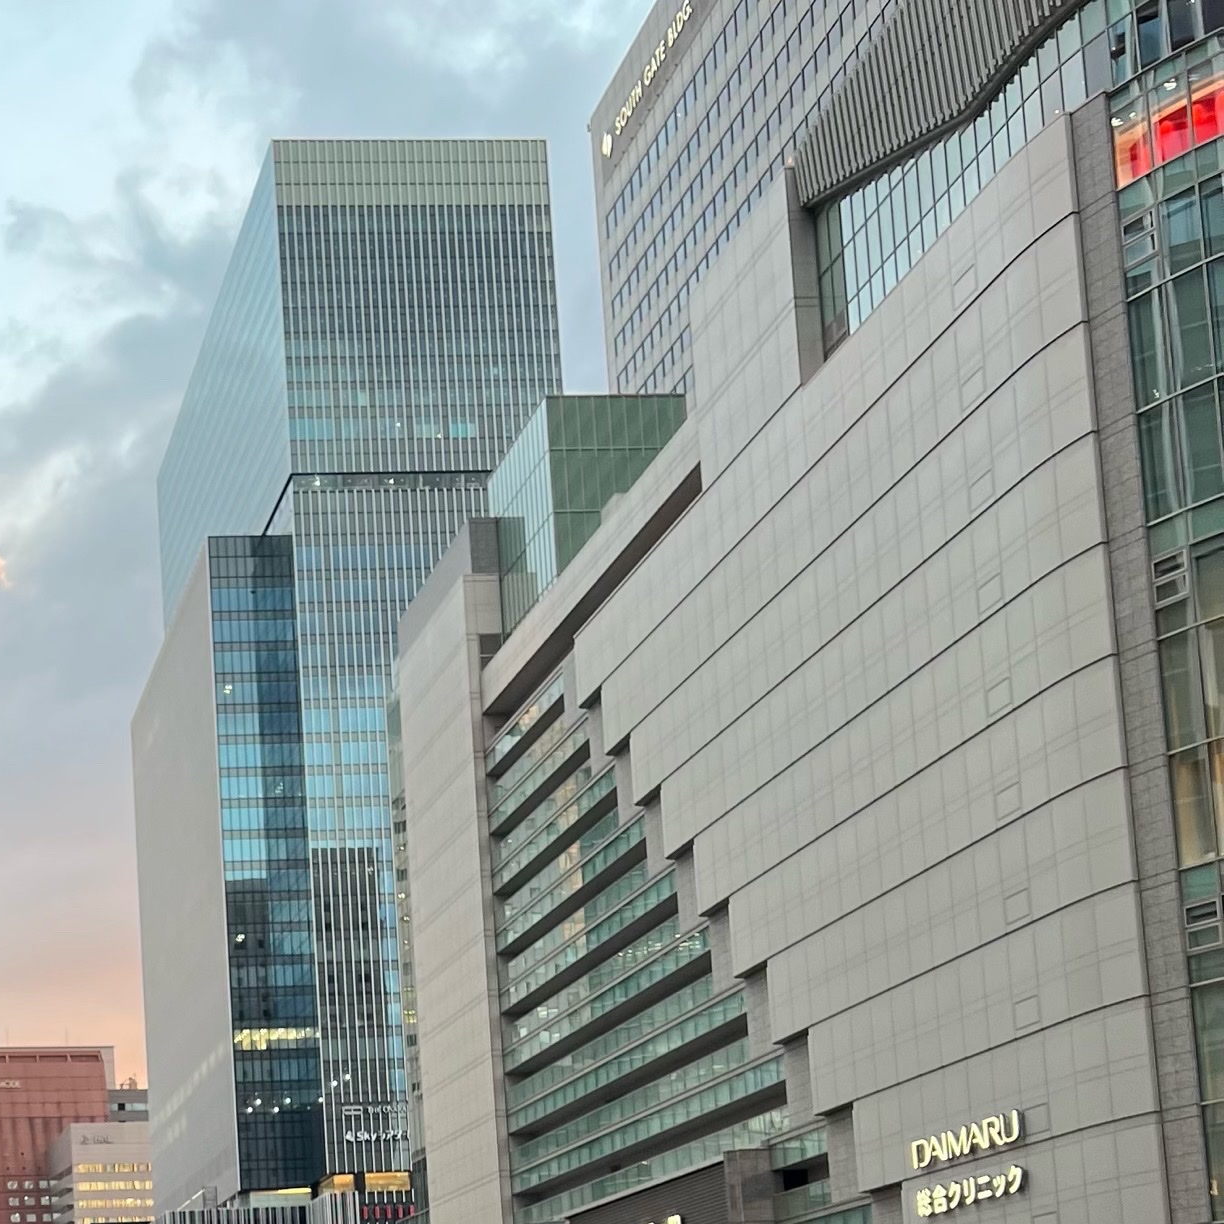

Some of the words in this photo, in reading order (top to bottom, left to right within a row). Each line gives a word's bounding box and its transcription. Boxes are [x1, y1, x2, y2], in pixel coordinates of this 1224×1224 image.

[614, 80, 643, 136] SOUTH
[643, 40, 666, 86] GATE
[910, 1109, 1021, 1170] DAIMARU
[916, 1164, 1024, 1217] 総合クリニック
